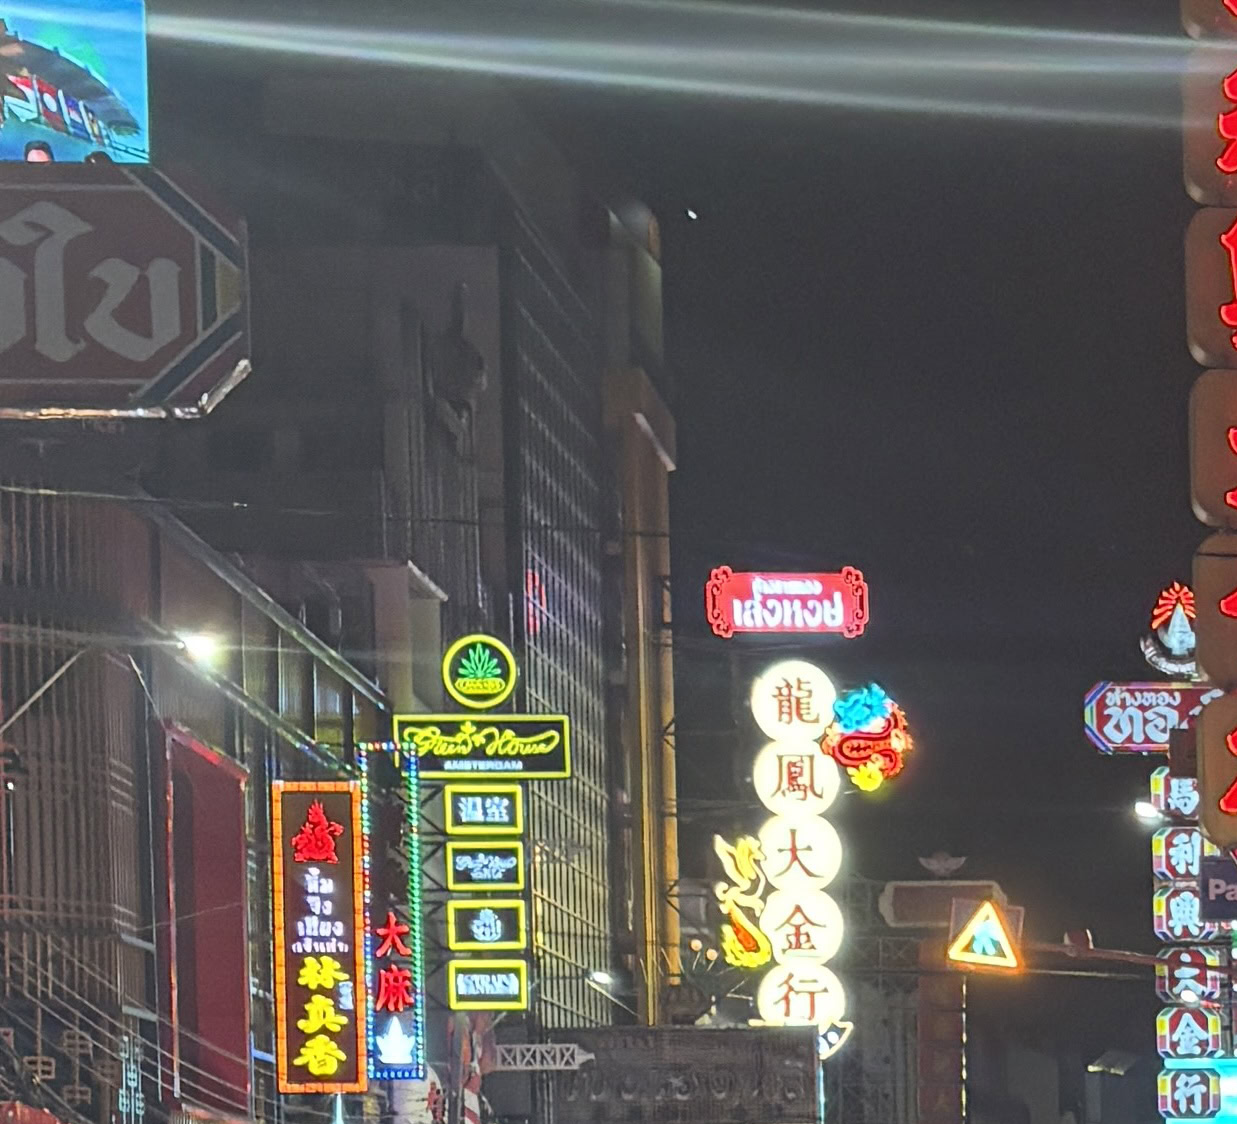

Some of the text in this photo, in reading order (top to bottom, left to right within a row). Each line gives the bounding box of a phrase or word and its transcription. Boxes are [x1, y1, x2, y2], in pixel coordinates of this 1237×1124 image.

[443, 760, 524, 771] AMSTERDAM
[771, 676, 831, 1021] 龍鳳大金行
[375, 911, 415, 1012] 大麻
